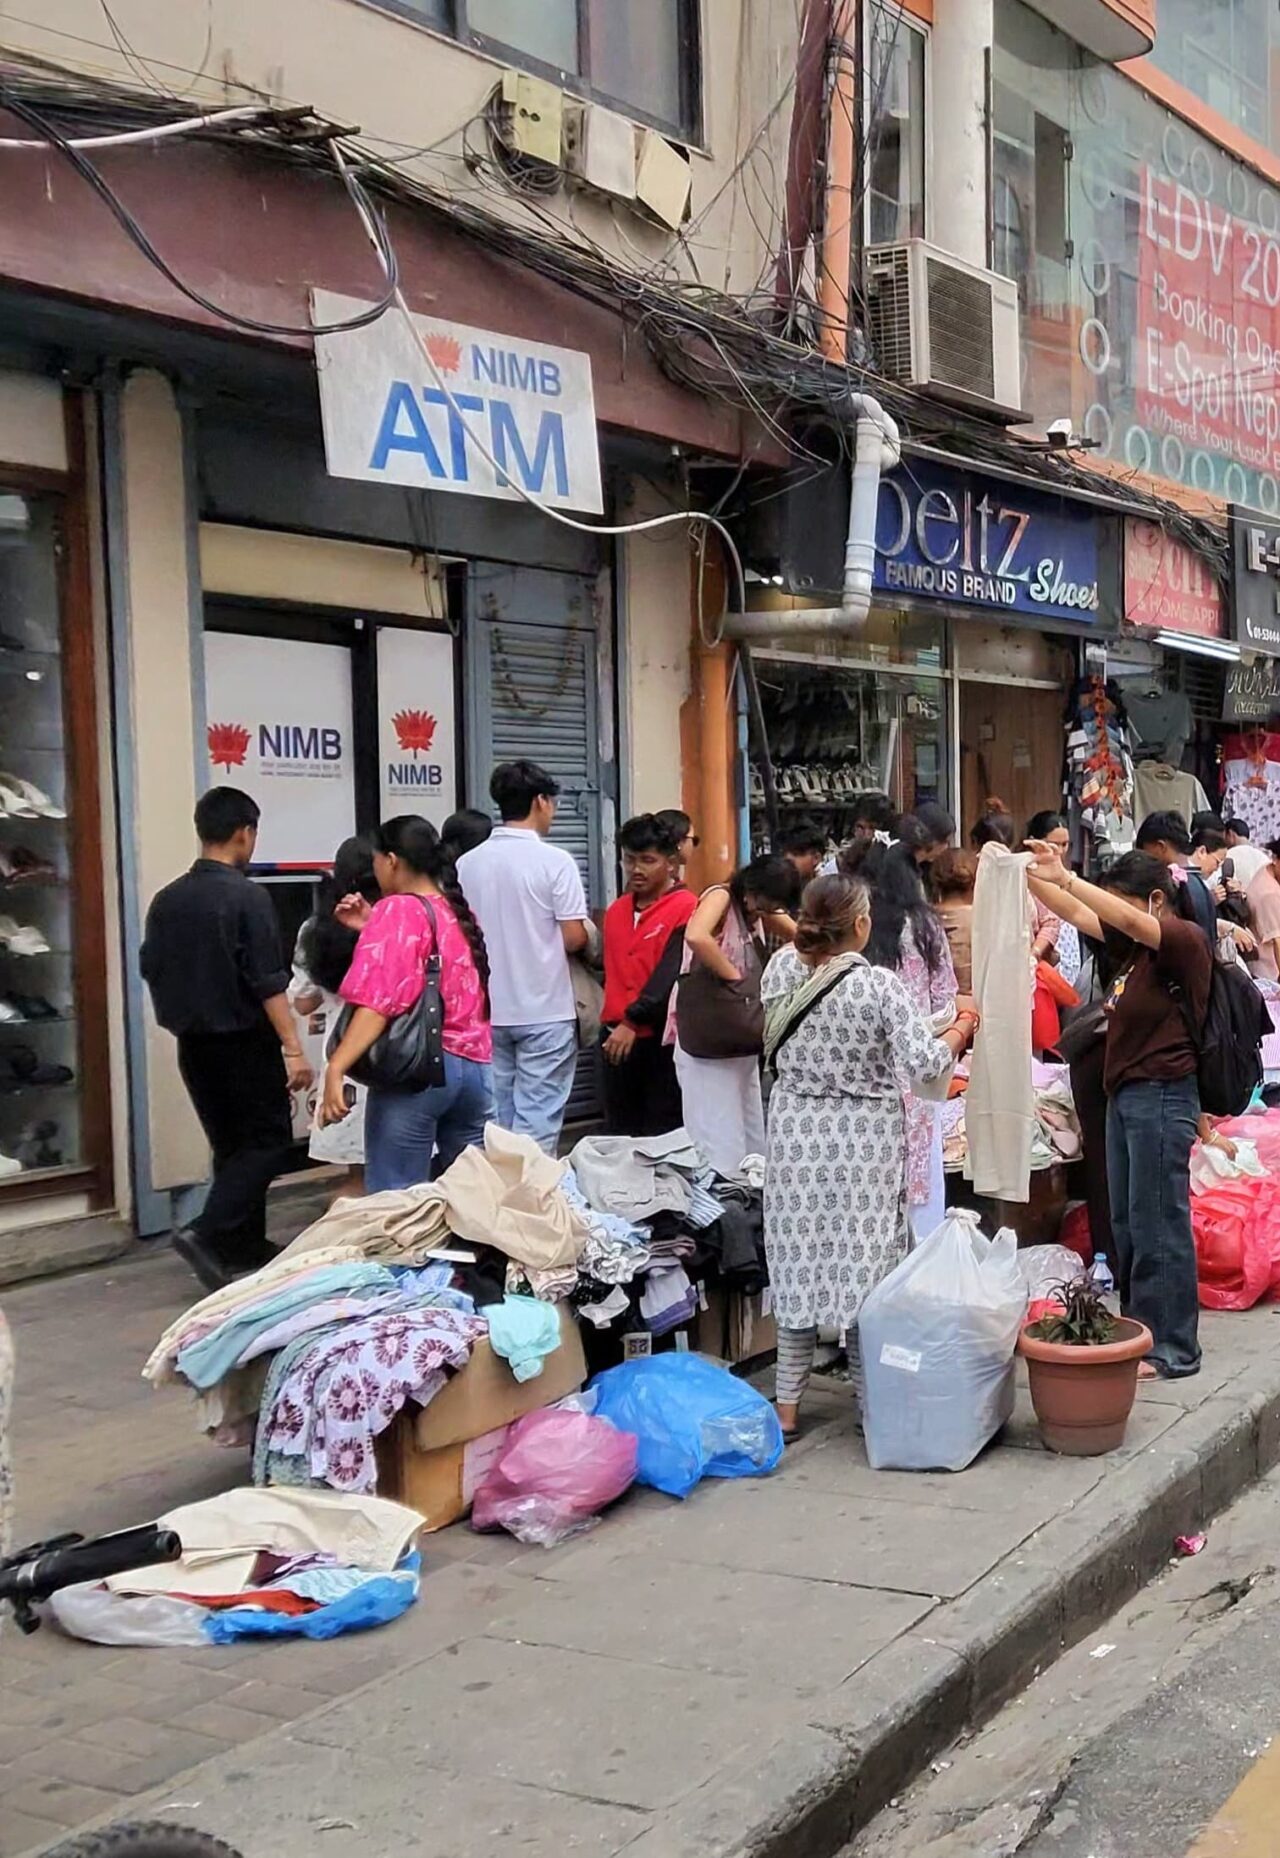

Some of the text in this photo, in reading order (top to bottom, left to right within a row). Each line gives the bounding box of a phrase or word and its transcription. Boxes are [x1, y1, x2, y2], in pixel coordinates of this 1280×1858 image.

[1146, 164, 1231, 276] EDV
[1154, 271, 1238, 360] Booking
[471, 343, 562, 397] NIMB
[1147, 327, 1228, 428] E-Spot
[368, 380, 570, 498] ATM
[885, 560, 1016, 605] FAMOUS BRAND
[1030, 558, 1099, 611] Shoes
[1149, 593, 1191, 623] HOME
[258, 724, 342, 761] NIMB
[388, 763, 443, 786] NIMB
